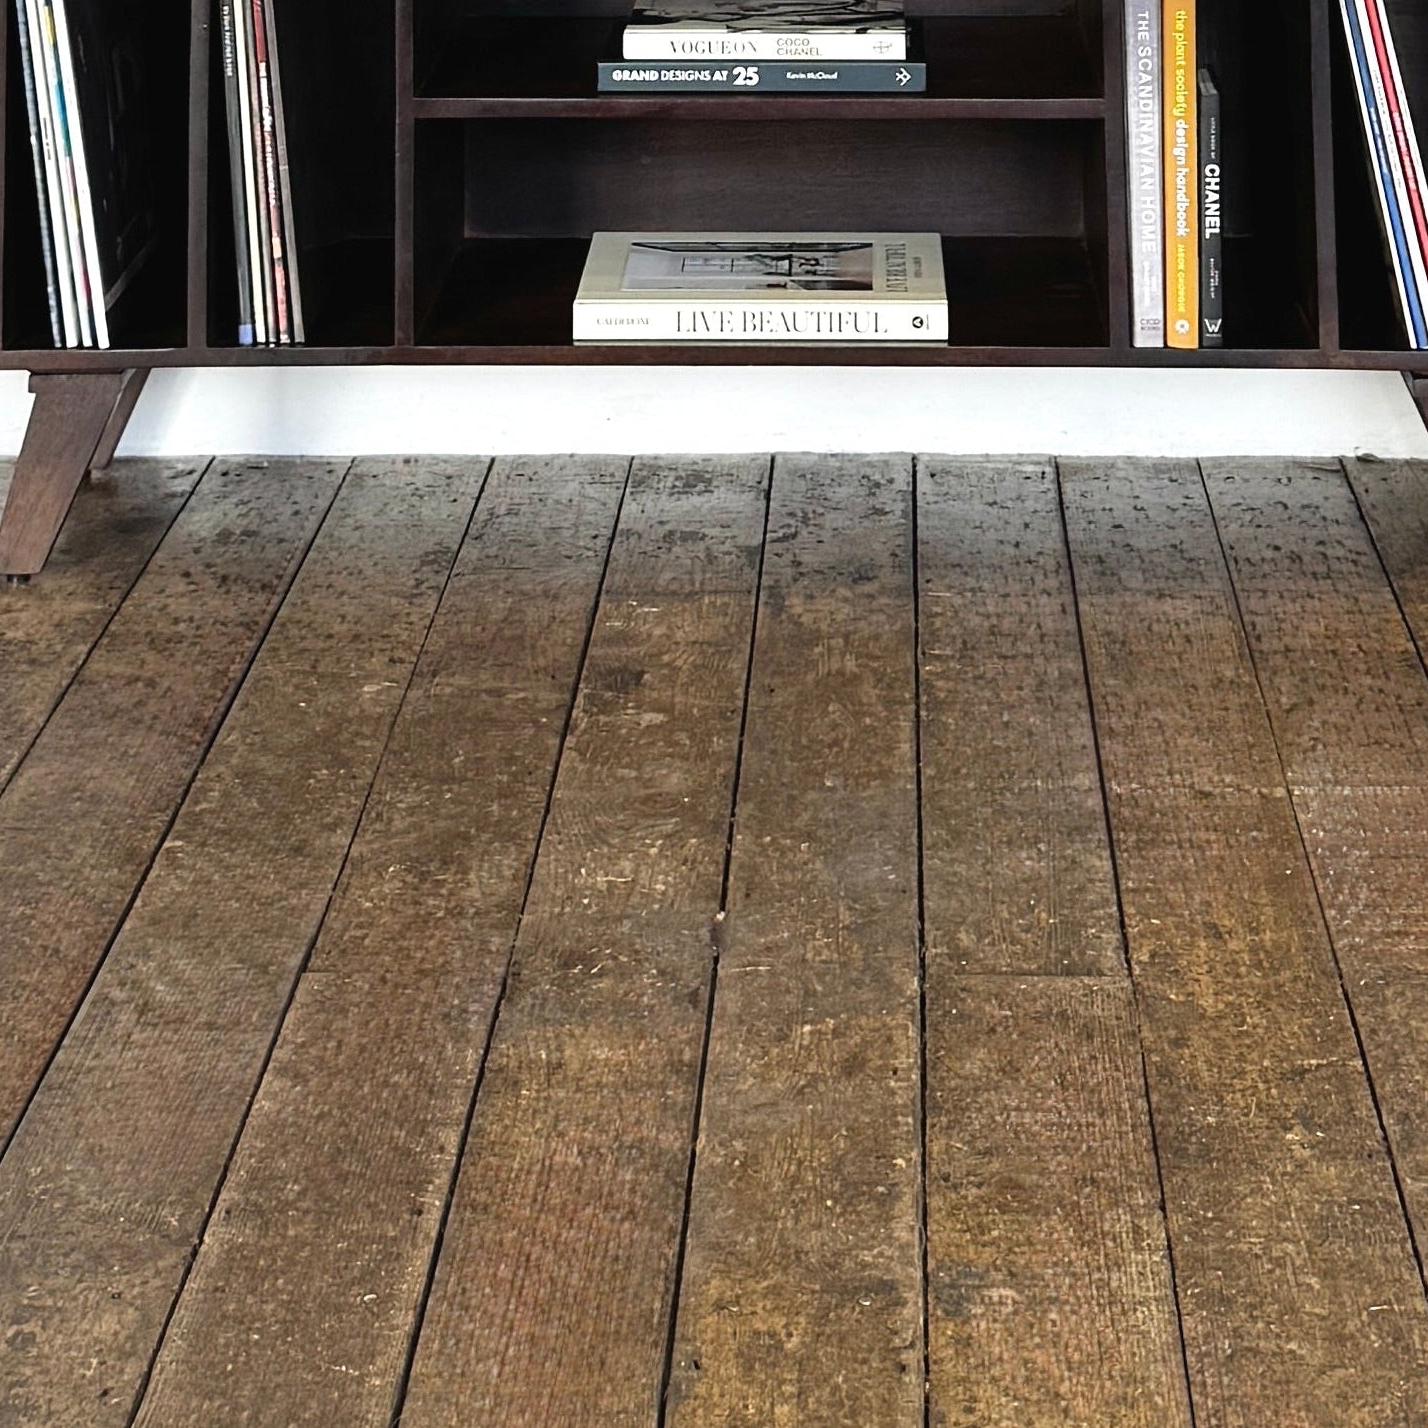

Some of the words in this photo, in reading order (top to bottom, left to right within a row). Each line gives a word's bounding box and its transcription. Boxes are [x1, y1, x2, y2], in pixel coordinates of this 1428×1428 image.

[1138, 10, 1150, 41] THE
[1175, 9, 1188, 31] the
[670, 40, 731, 55] VOGUE
[776, 37, 810, 47] COCO
[776, 47, 822, 56] CHANEL
[1172, 32, 1188, 66] plant
[612, 69, 659, 82] GRAND
[660, 69, 712, 81] DESIGNS
[712, 70, 729, 81] AT
[732, 66, 760, 86] 25
[1172, 68, 1189, 117] society
[1138, 46, 1155, 191] SCANDINAVIAN
[1172, 118, 1189, 165] design
[1176, 167, 1190, 237] handbook
[1204, 163, 1220, 240] CHANEL
[1140, 196, 1157, 253] HOME
[677, 310, 734, 333] LIVE
[743, 310, 888, 334] BEAUTIFUL
